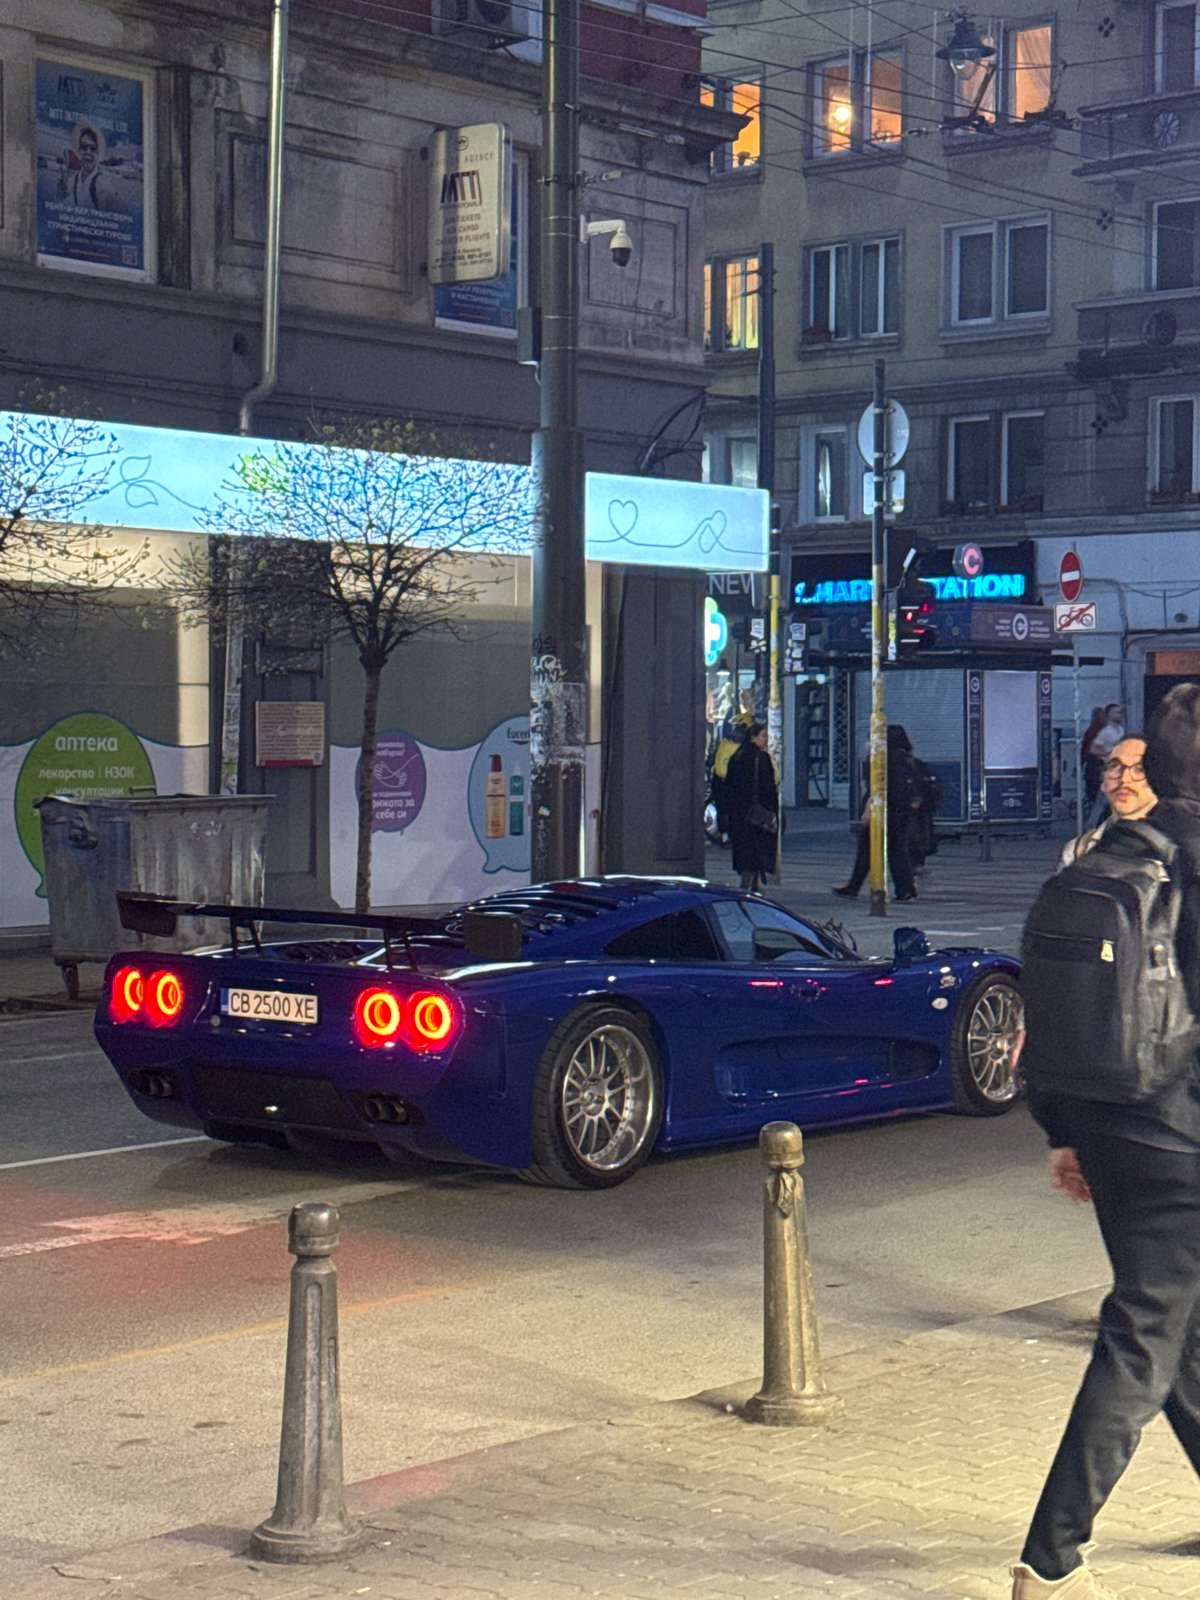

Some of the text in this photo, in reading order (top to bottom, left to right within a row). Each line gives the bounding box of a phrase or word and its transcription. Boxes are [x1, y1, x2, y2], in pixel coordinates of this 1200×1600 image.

[918, 573, 1025, 600] TATION
[55, 737, 118, 751] аптека
[38, 766, 135, 781] лекарства НЗОК
[372, 799, 404, 809] рижата
[376, 808, 396, 819] себе
[230, 992, 315, 1019] CB 2500 XE
